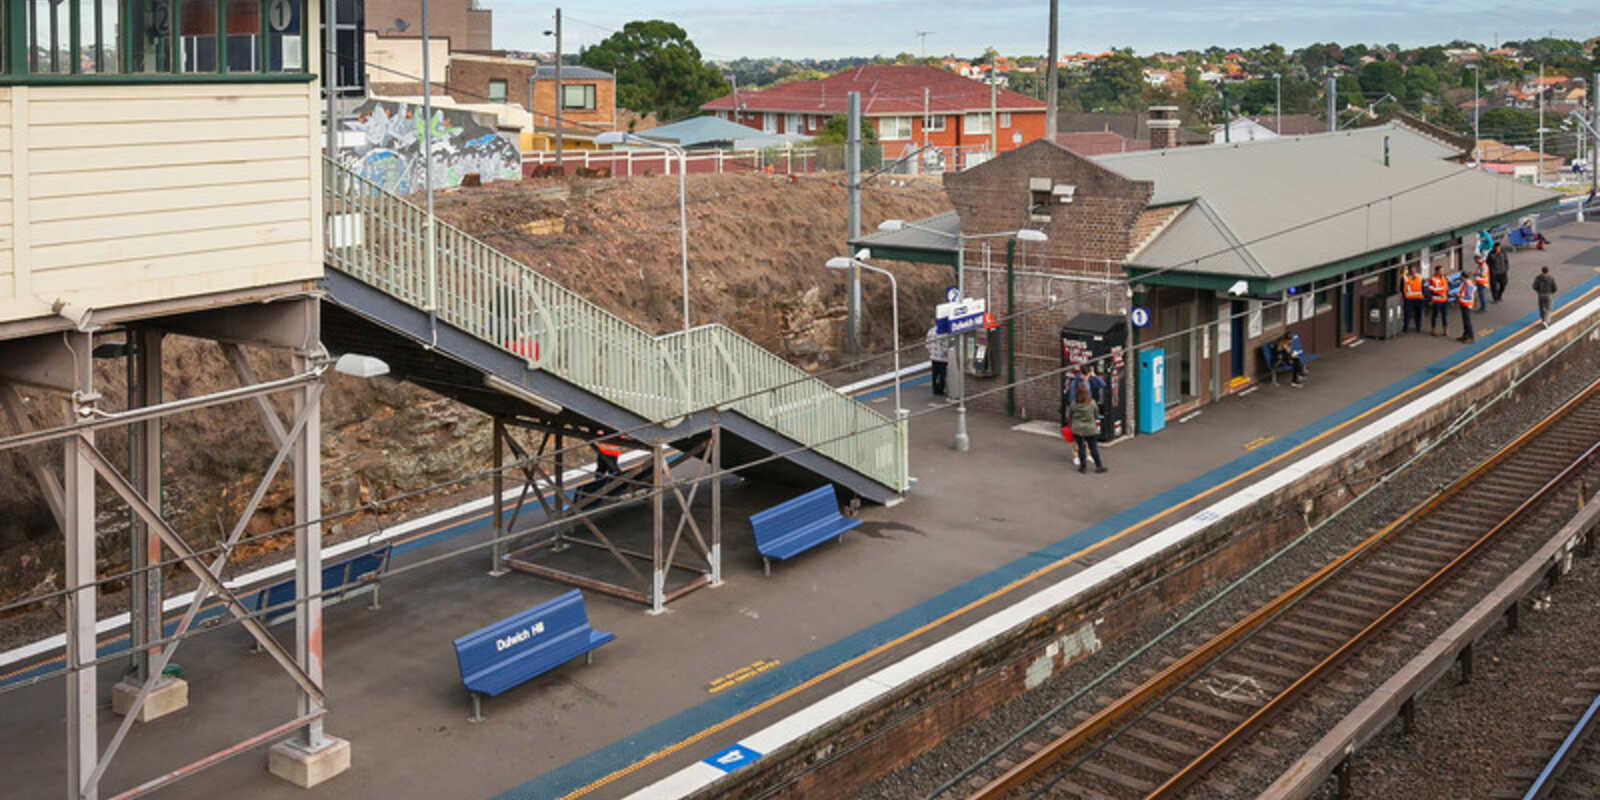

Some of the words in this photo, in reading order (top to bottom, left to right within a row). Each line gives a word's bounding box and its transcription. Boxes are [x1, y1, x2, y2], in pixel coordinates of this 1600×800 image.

[274, 1, 284, 27] 1
[496, 629, 530, 652] Dulwich
[531, 621, 545, 636] Hill
[717, 750, 744, 764] 4
